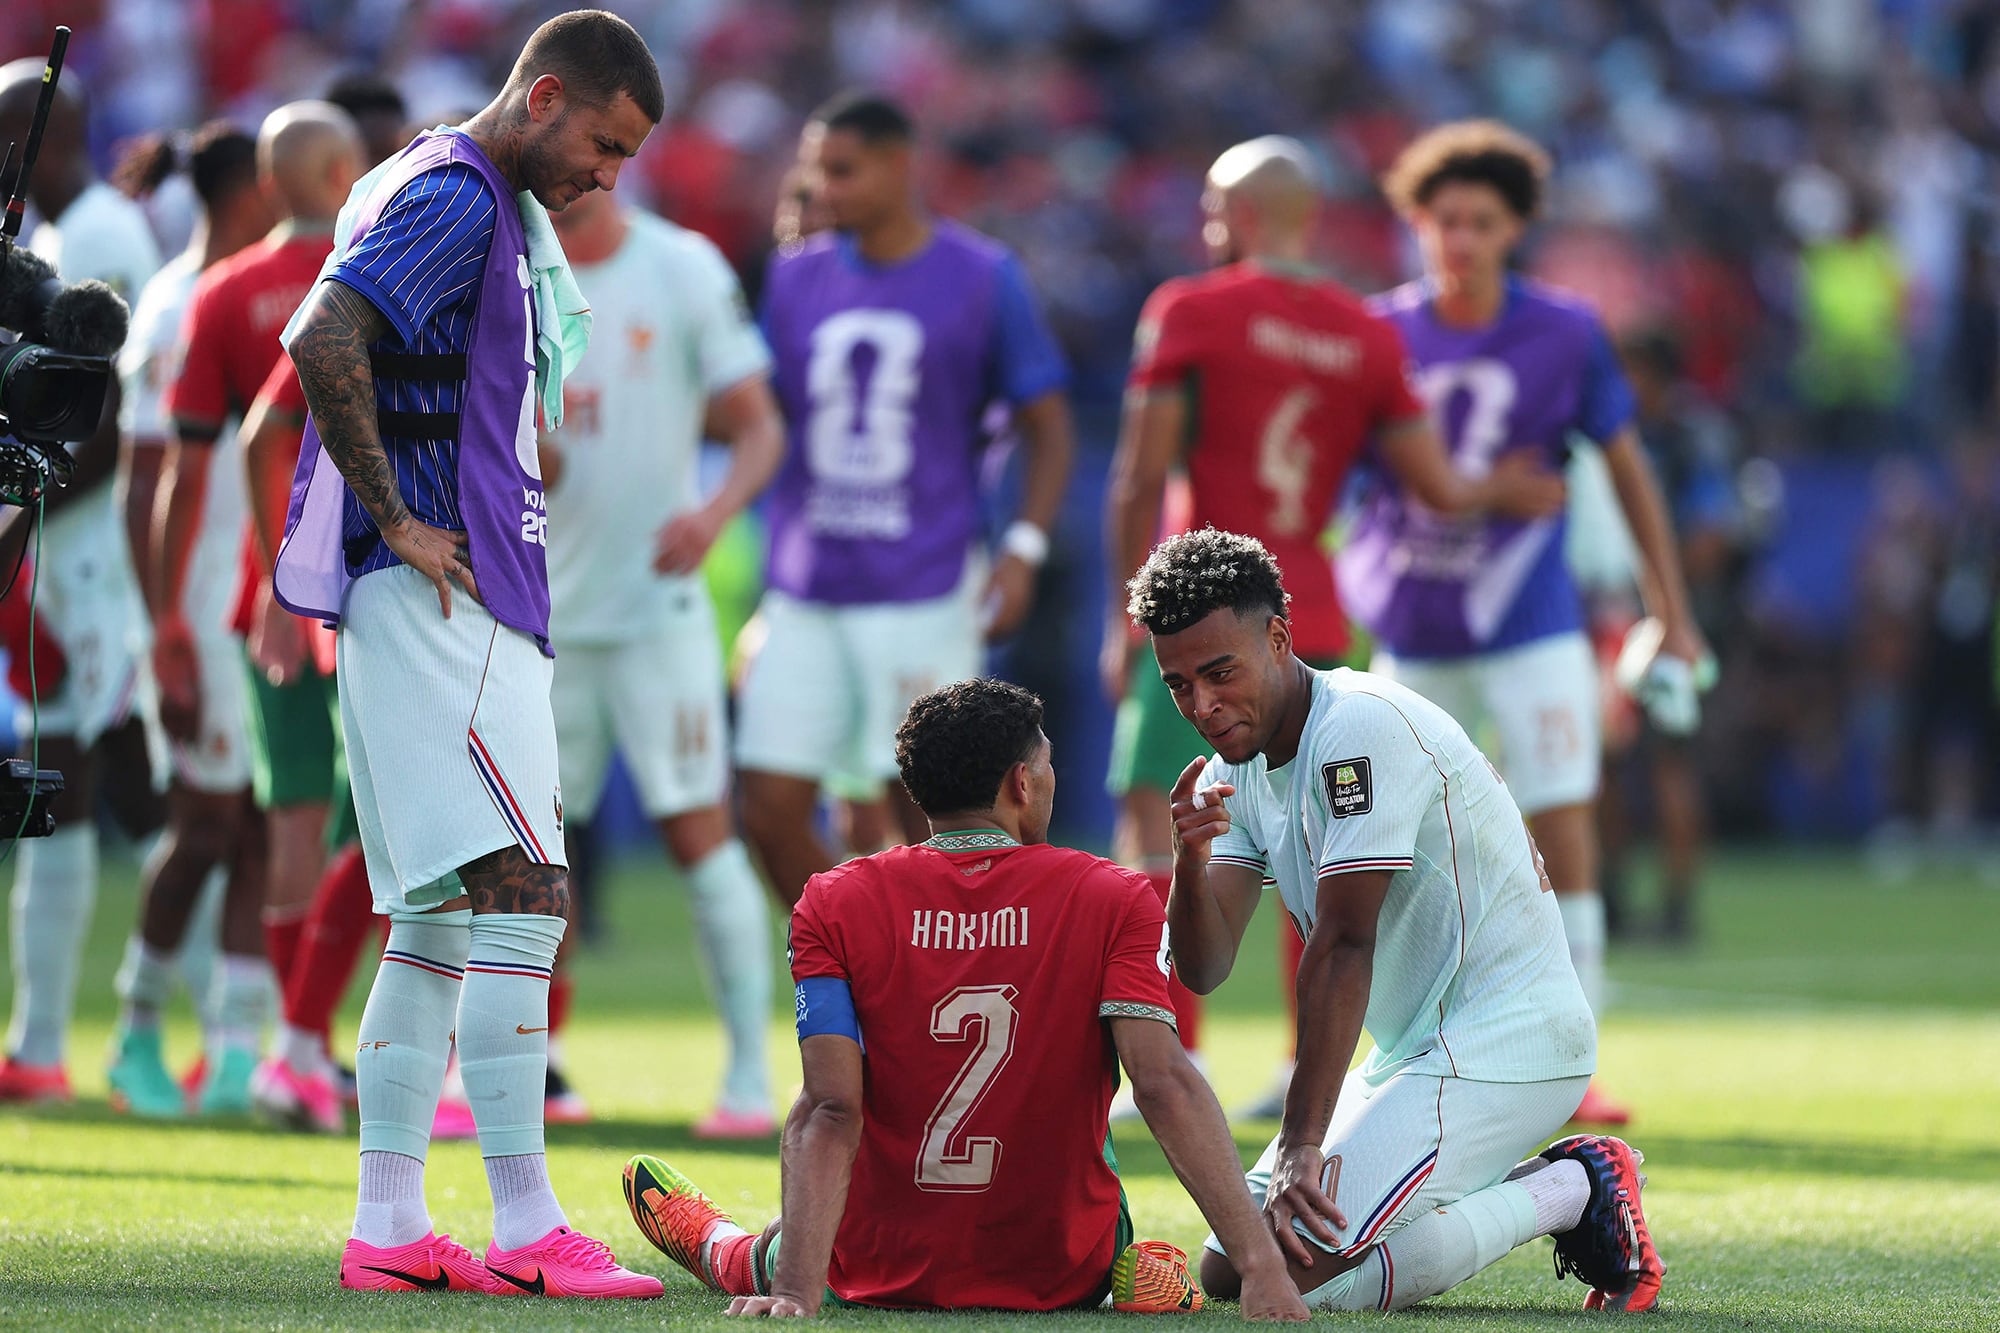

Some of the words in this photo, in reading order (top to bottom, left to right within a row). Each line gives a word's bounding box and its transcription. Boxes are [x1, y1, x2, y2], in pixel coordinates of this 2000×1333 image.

[1256, 388, 1320, 534] 4
[1334, 793, 1365, 807] EDUCATION
[911, 906, 1029, 950] HAKIMI
[914, 984, 1020, 1193] 2
